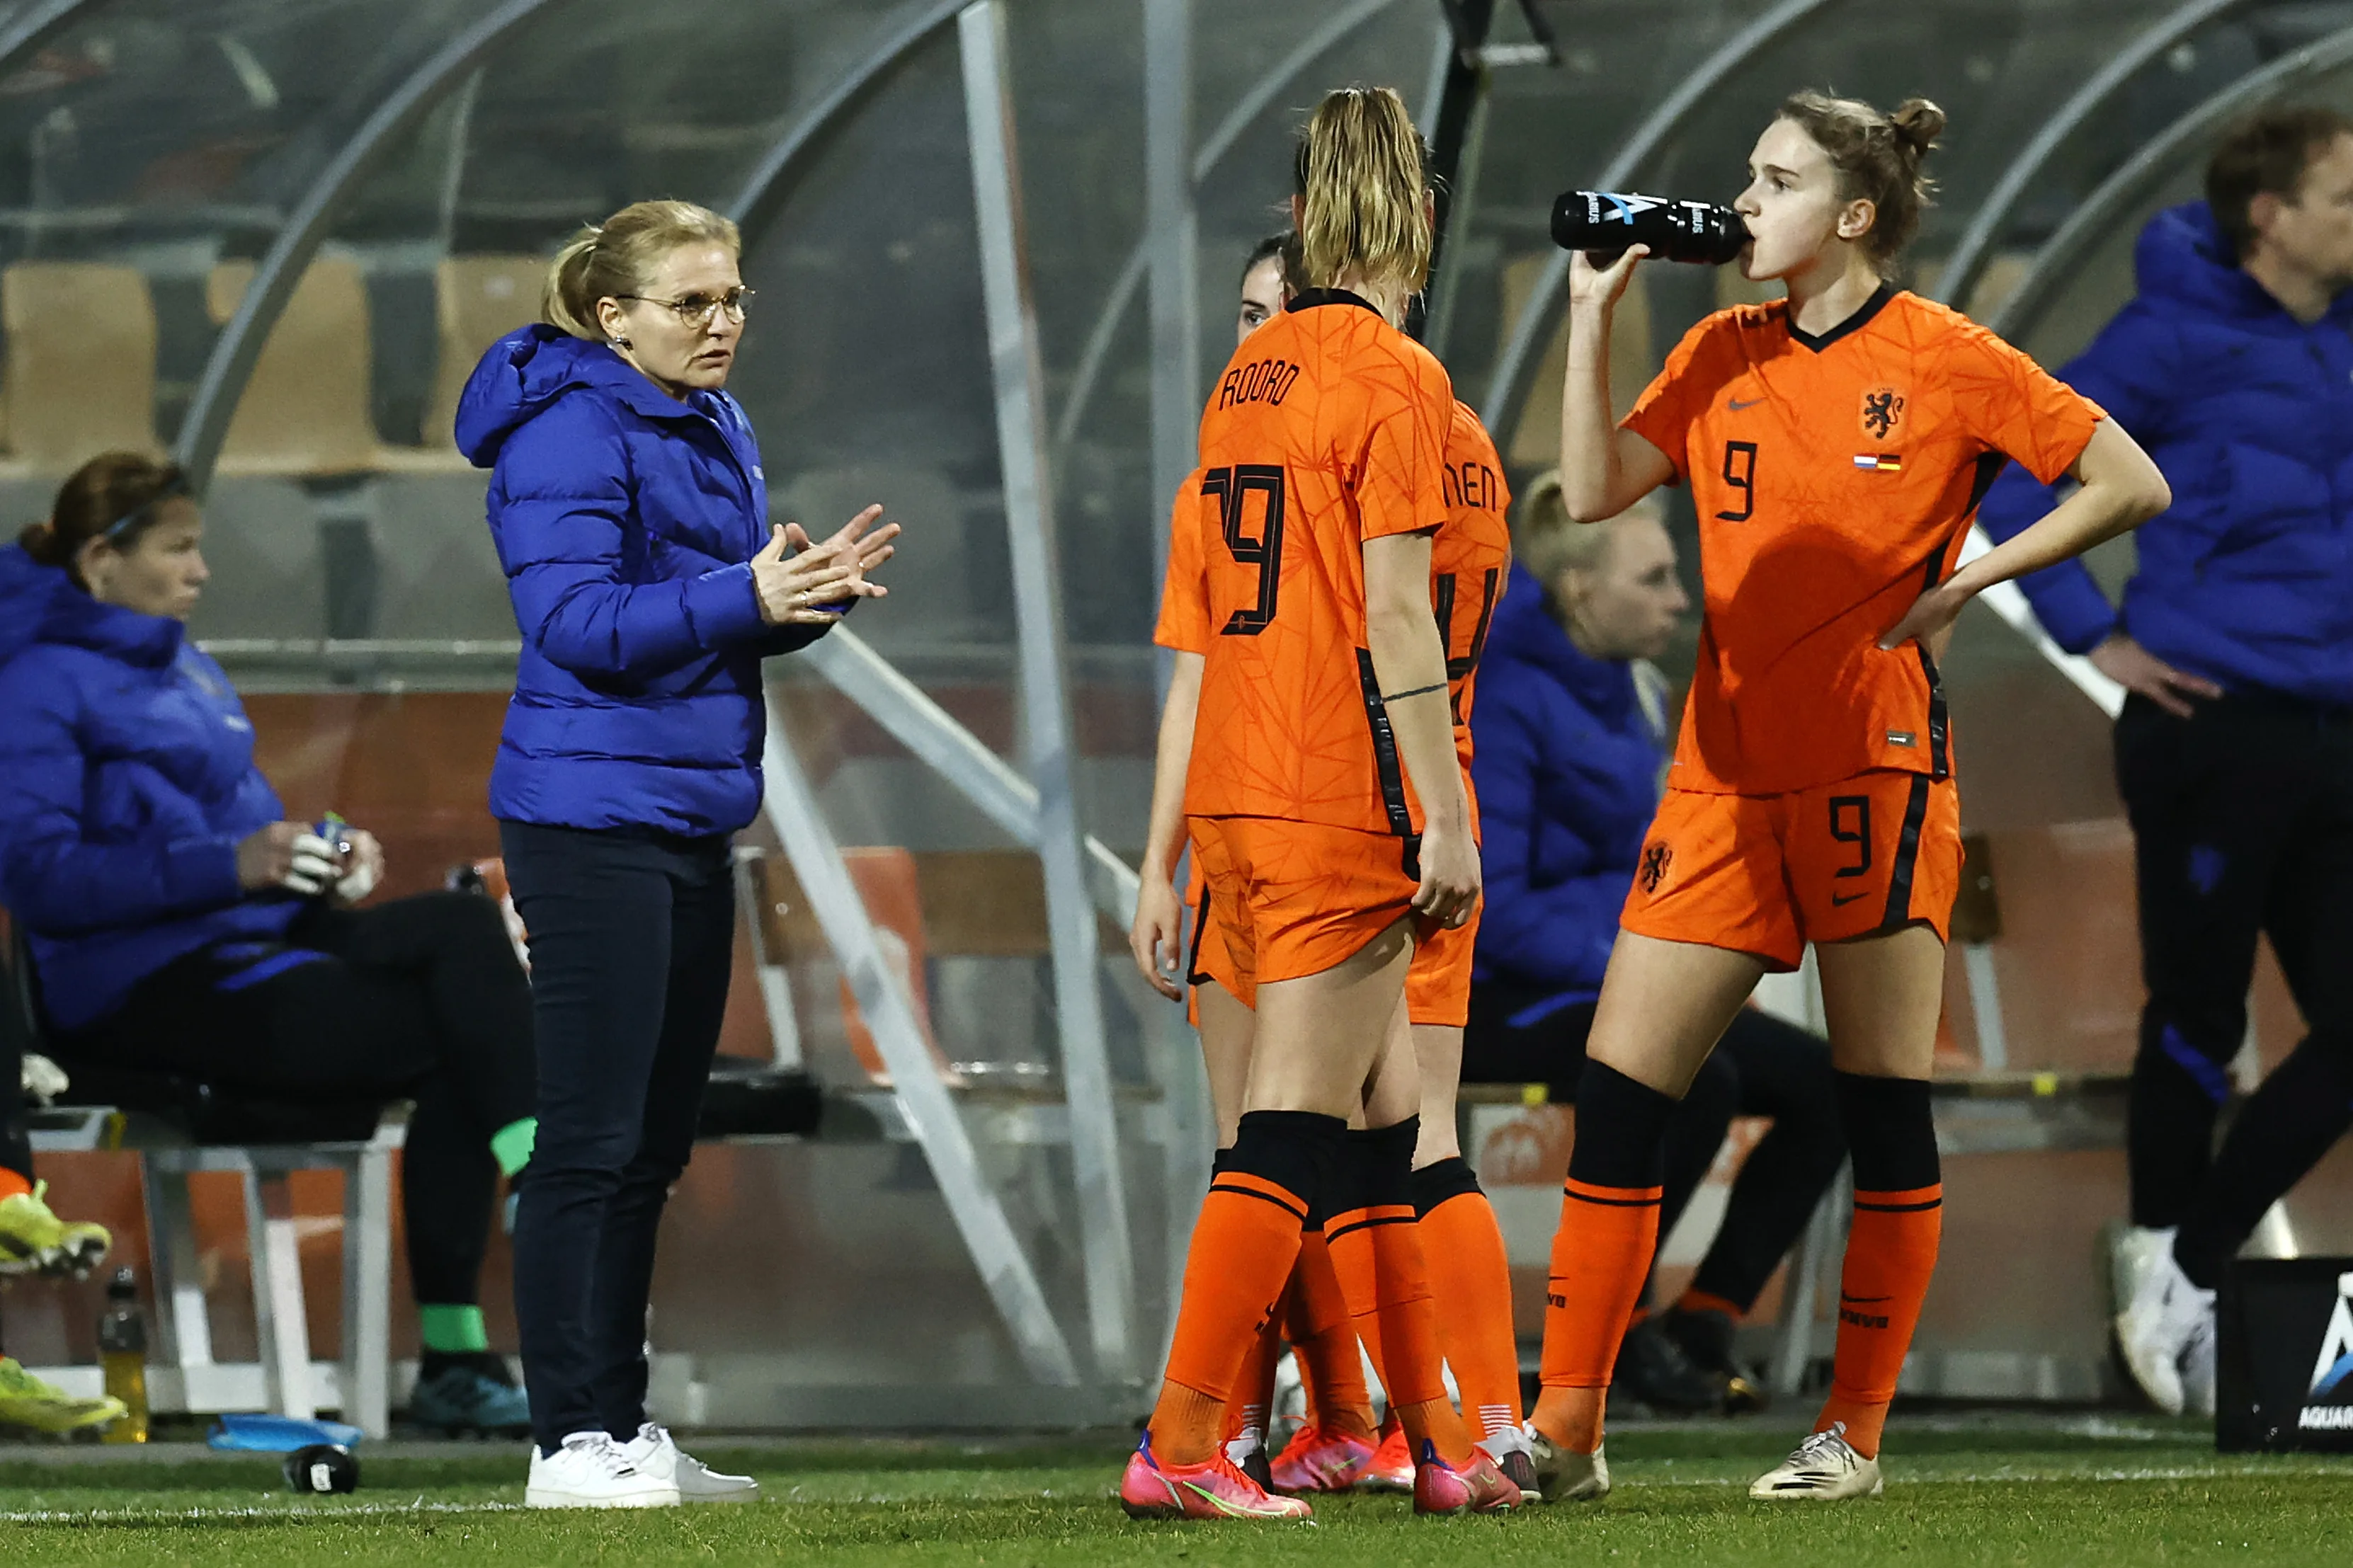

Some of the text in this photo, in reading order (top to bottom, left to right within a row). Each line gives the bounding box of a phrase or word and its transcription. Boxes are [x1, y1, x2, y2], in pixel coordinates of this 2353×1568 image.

[1219, 359, 1300, 411] ROORD
[1715, 440, 1757, 522] 9
[1200, 464, 1284, 636] 19
[1829, 796, 1871, 878] 9
